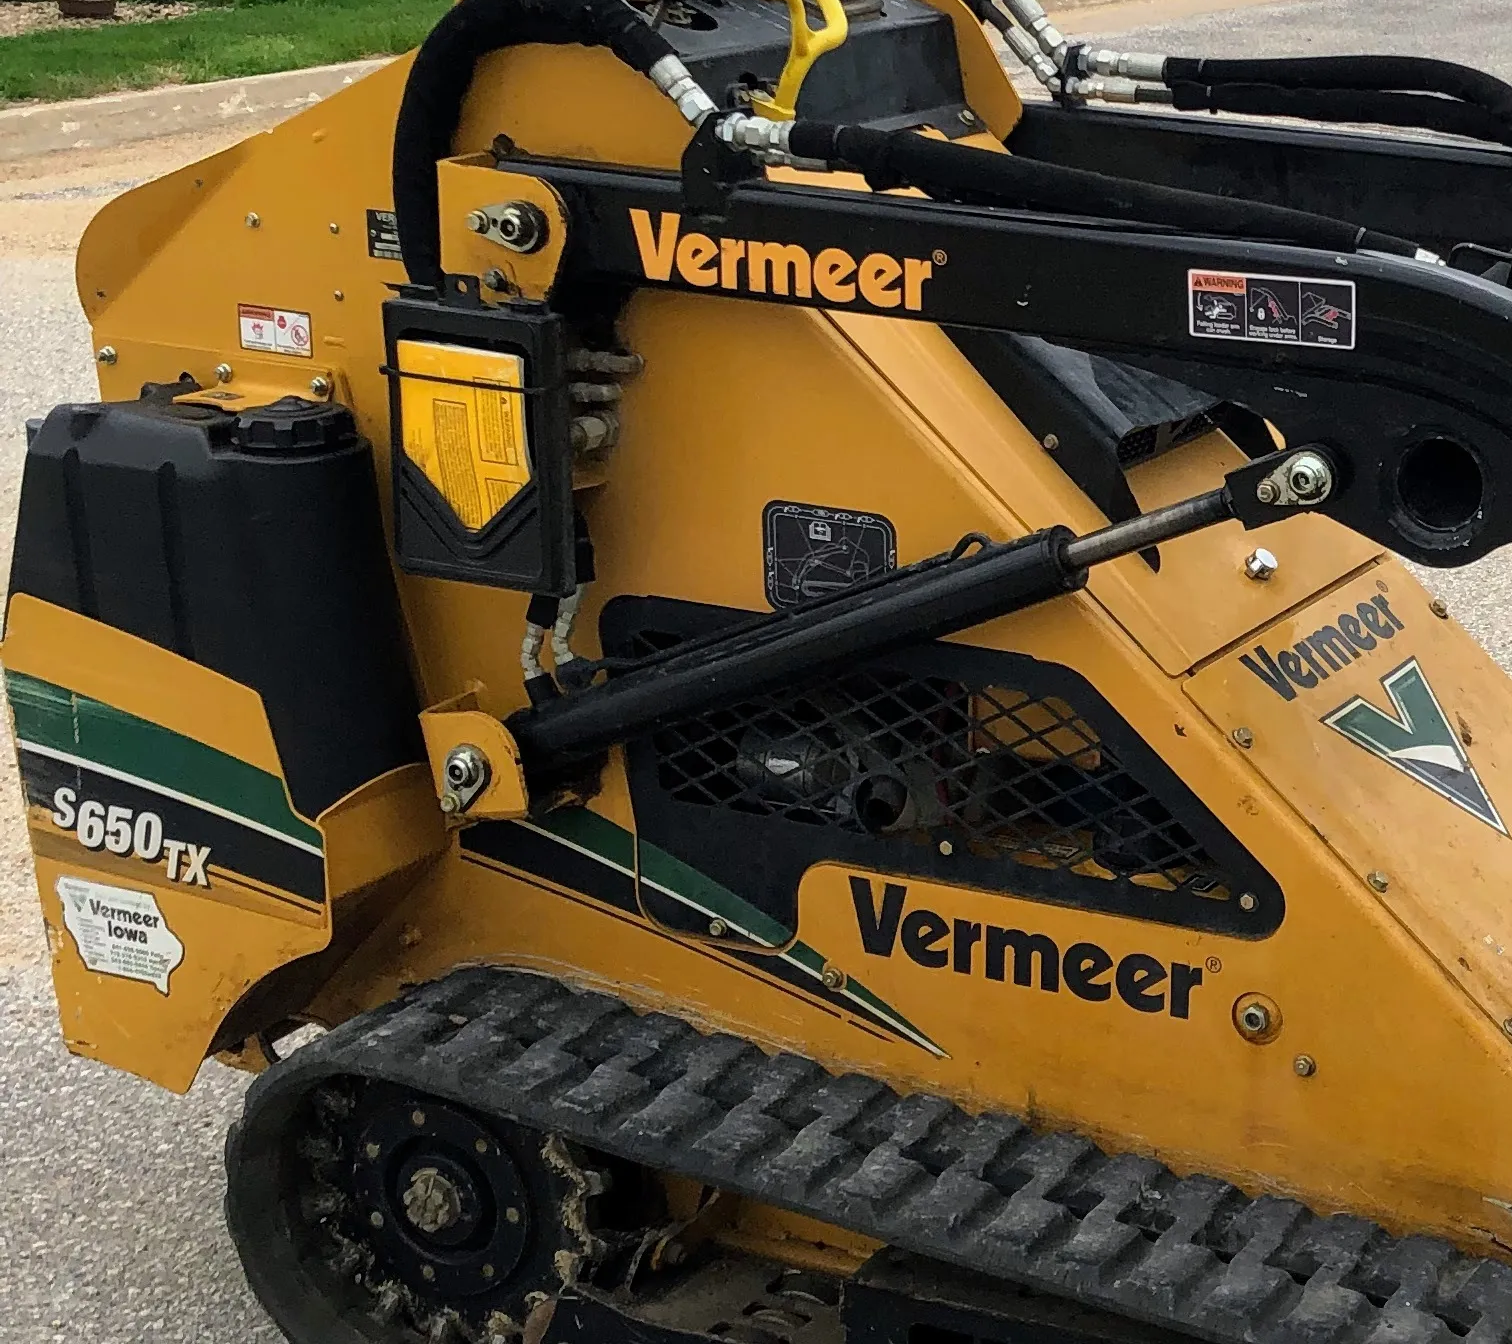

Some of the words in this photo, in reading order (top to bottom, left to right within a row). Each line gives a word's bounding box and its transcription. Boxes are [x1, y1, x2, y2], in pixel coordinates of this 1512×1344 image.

[1203, 277, 1244, 289] WARNING
[88, 898, 160, 929] Vermeer
[107, 920, 148, 945] Iowa
